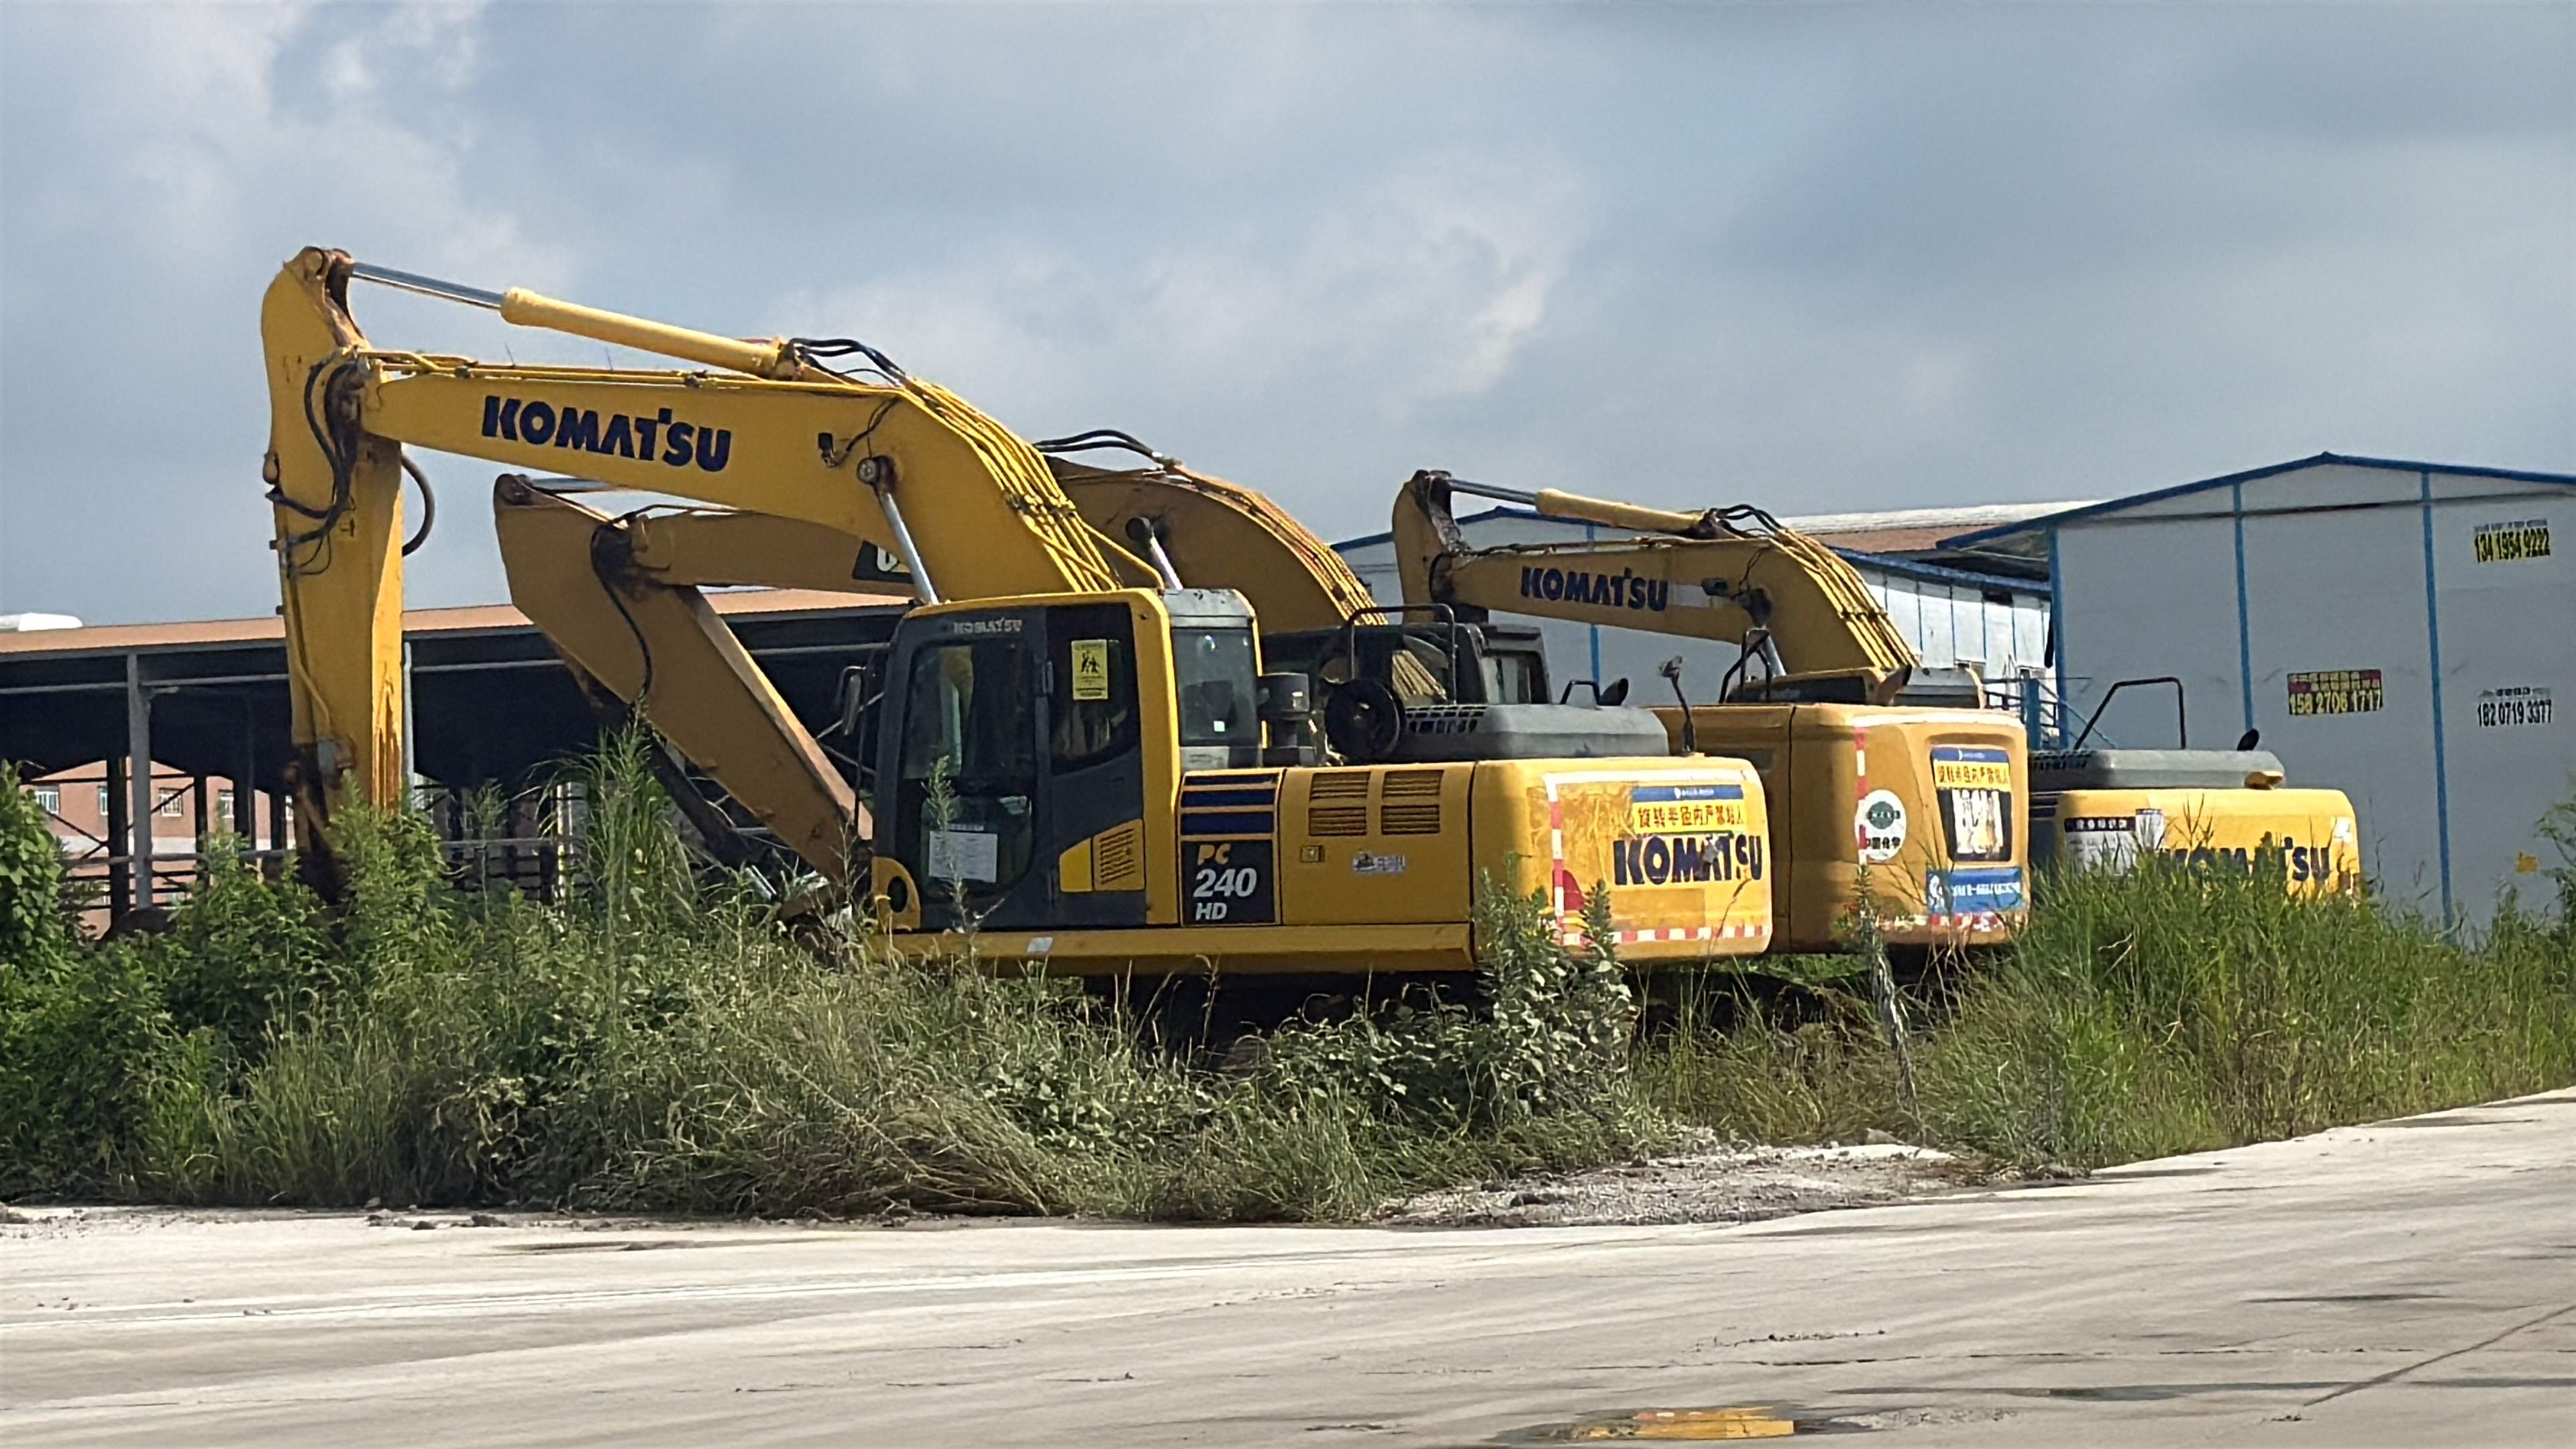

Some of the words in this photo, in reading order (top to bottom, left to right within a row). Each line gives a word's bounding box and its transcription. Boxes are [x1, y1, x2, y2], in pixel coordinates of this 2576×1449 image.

[481, 395, 731, 472] KOMATSU
[1520, 566, 1668, 611] KOMATSU
[953, 617, 1022, 634] KOMATSU
[1197, 844, 1231, 865] PC
[1613, 834, 1762, 885] KOMATSU
[1193, 867, 1257, 898] 240
[1195, 902, 1227, 920] HD
